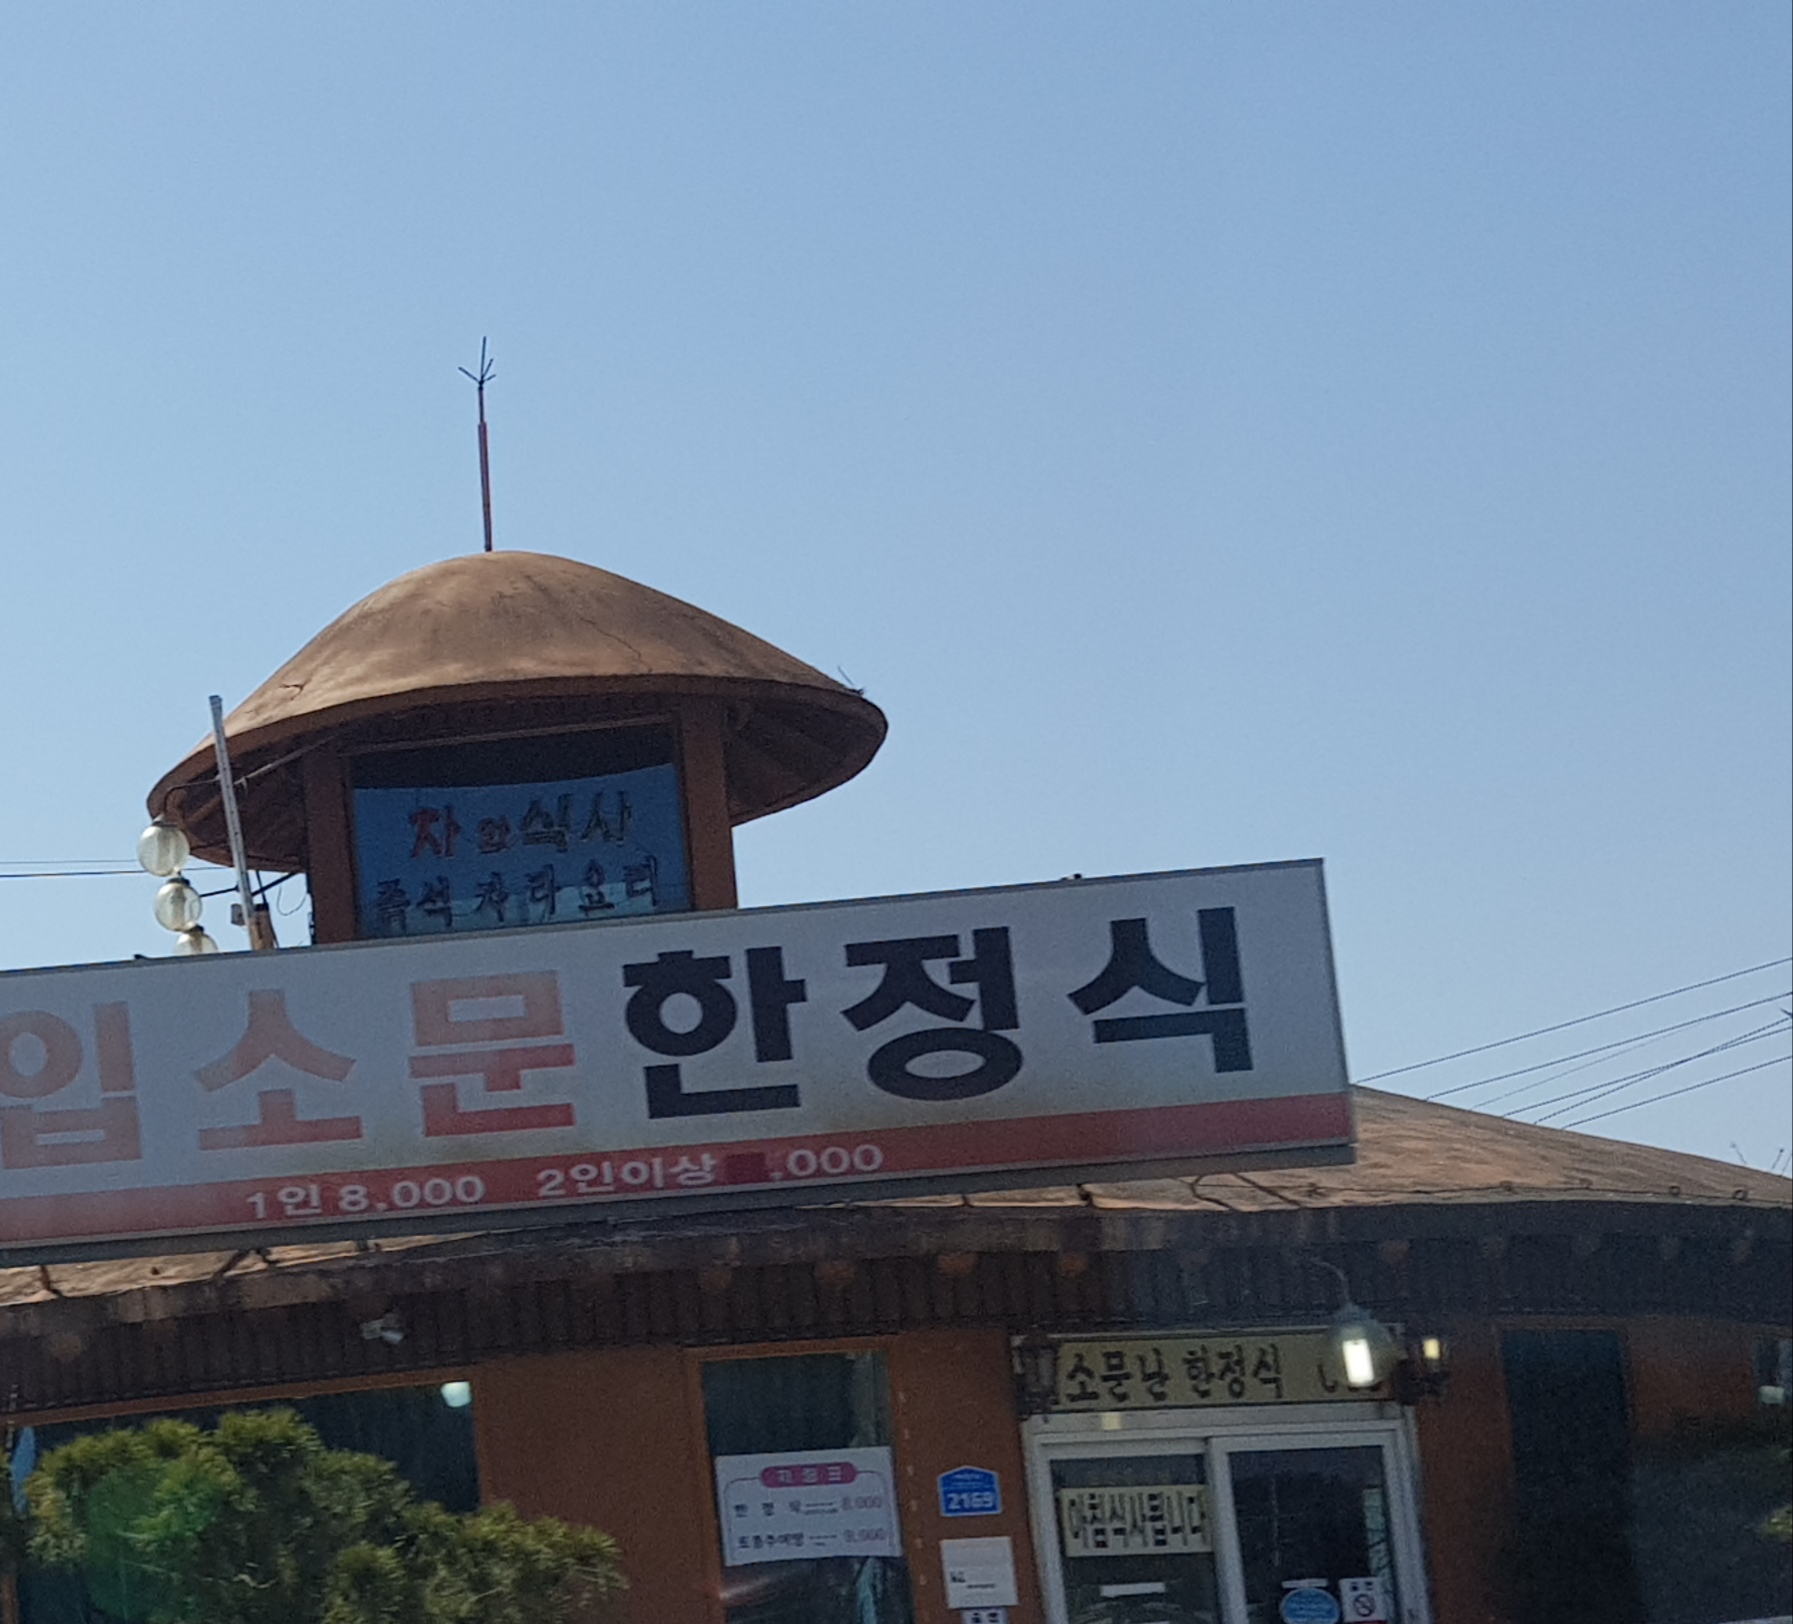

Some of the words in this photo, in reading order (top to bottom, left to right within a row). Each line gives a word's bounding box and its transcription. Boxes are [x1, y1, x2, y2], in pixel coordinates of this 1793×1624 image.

[622, 906, 1254, 1119] 한정식
[246, 1184, 323, 1219] 1인
[1065, 1347, 1170, 1402] 소문난
[1182, 1342, 1284, 1400] 한정식
